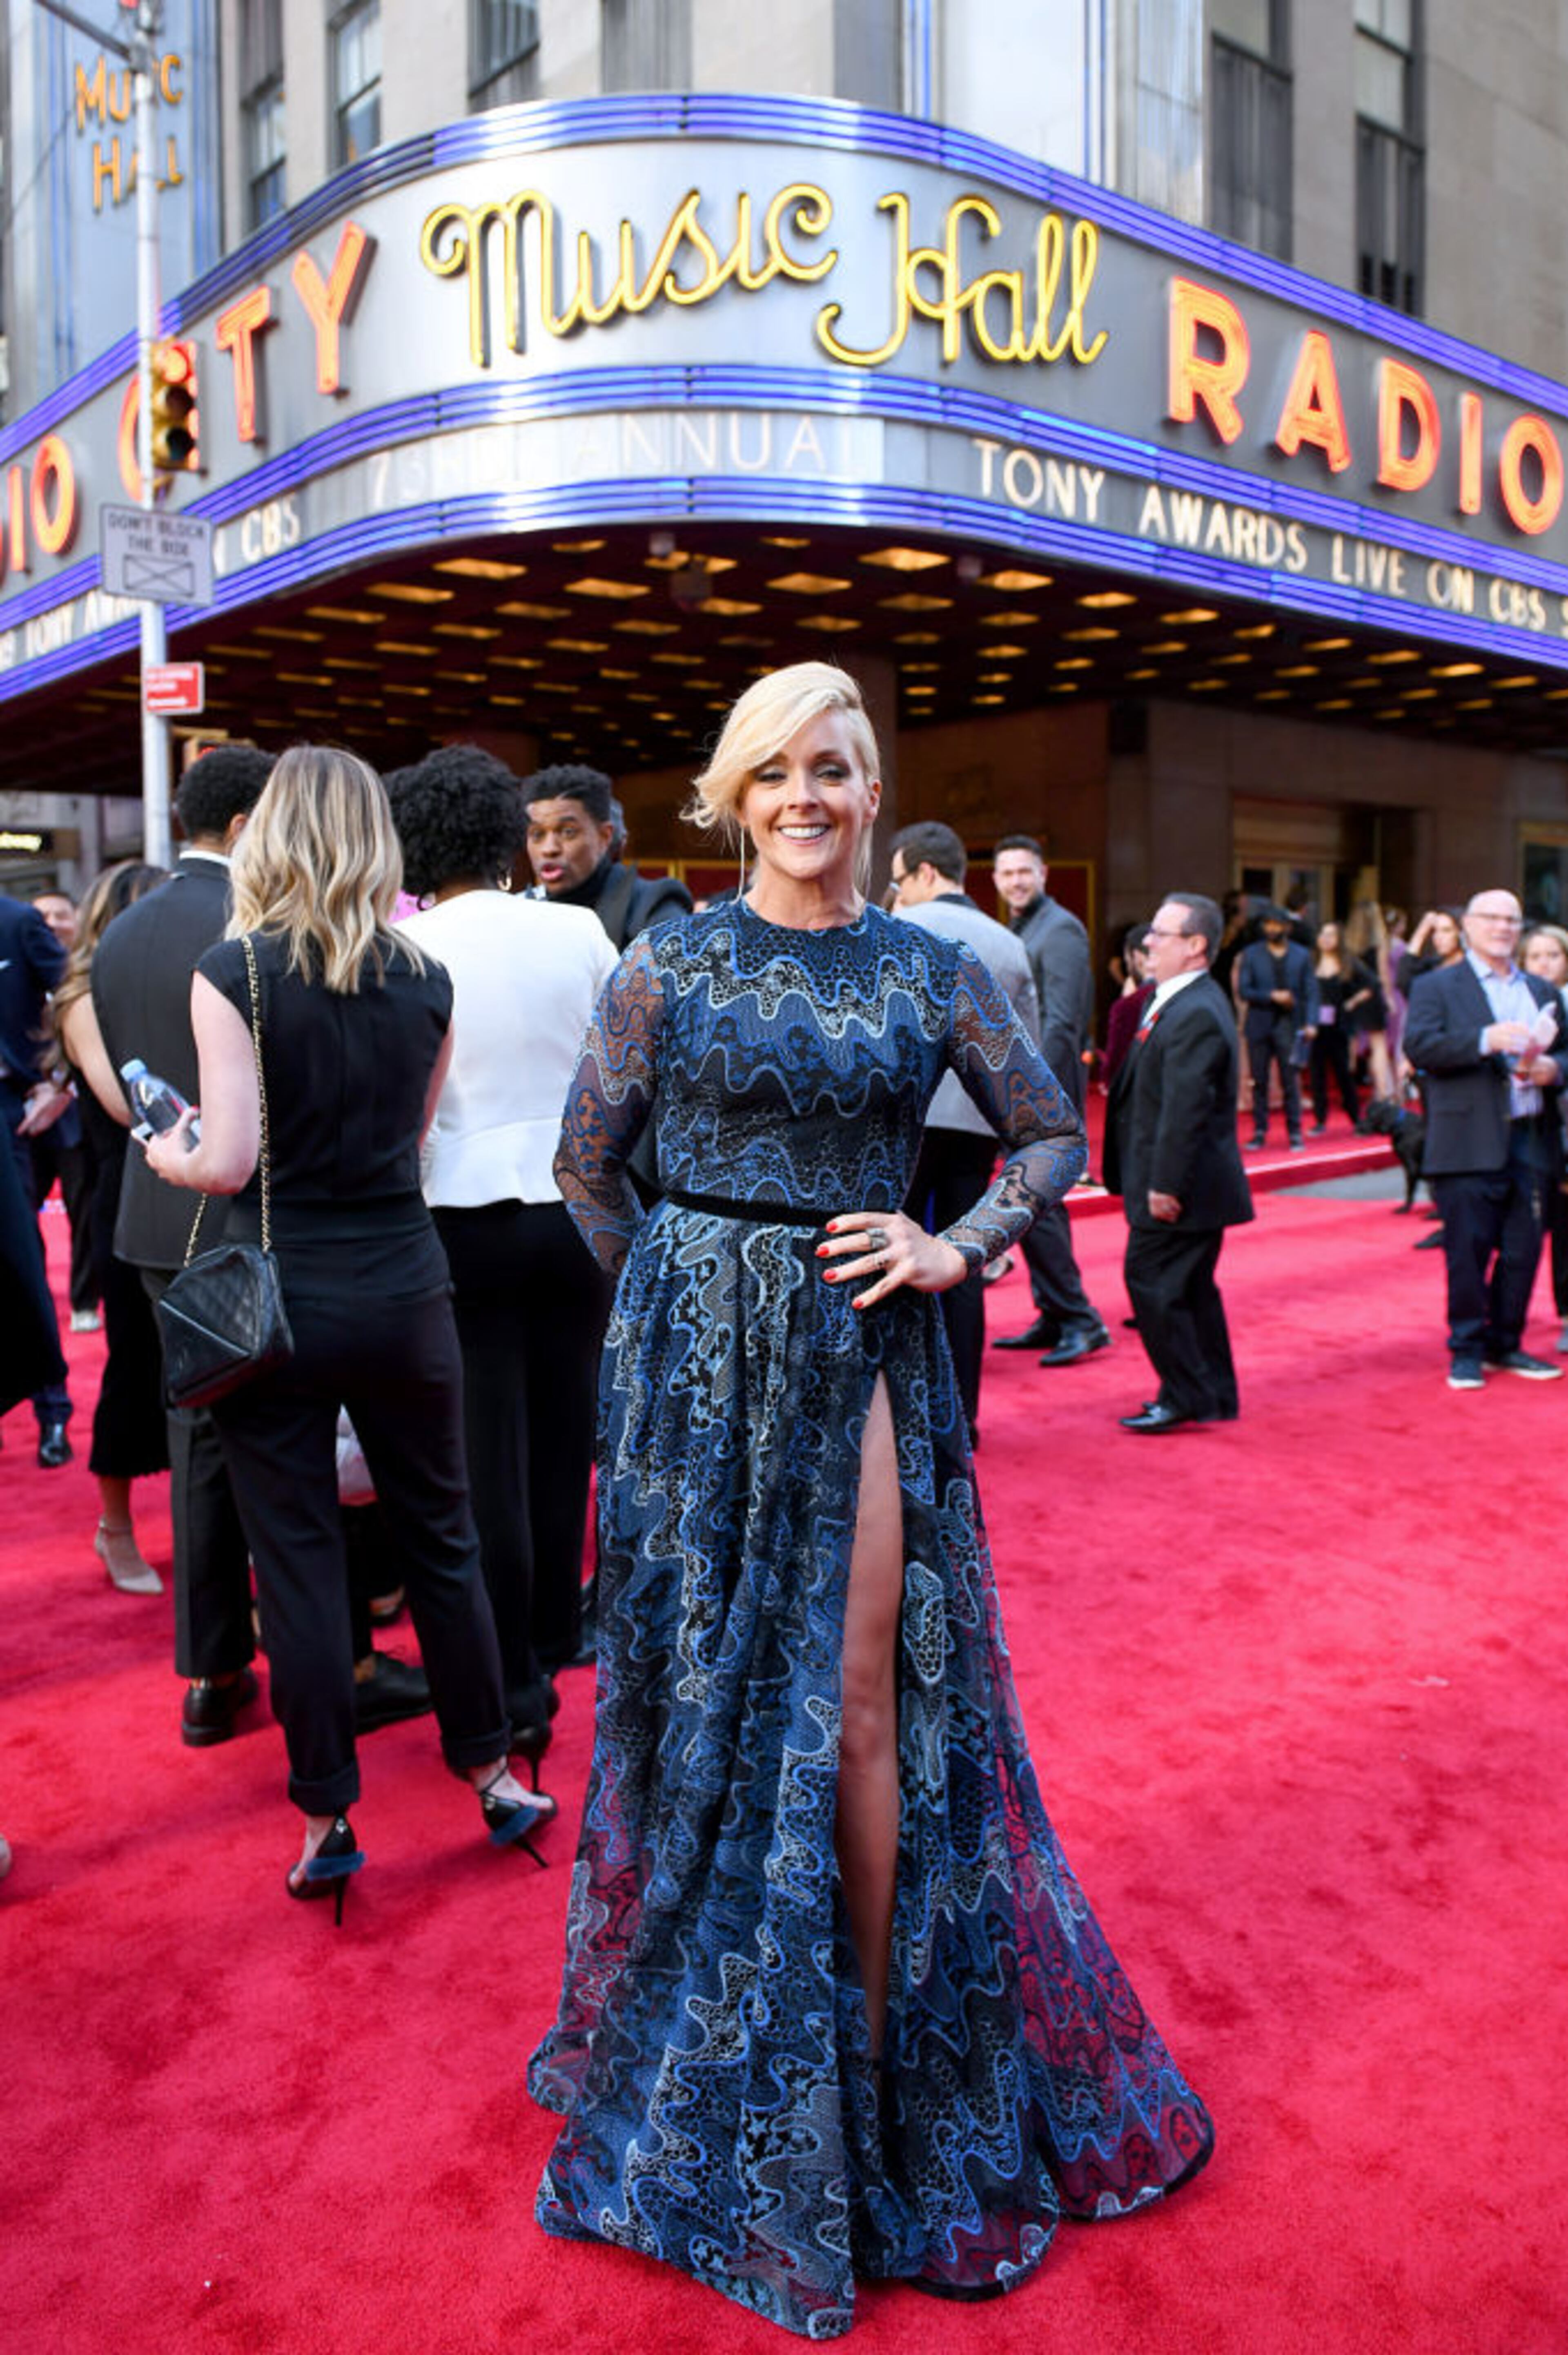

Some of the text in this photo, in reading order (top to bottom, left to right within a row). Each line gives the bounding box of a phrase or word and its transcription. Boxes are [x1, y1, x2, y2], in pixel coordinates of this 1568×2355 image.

[76, 54, 183, 129] MUC
[92, 136, 183, 210] HL
[816, 191, 1108, 365] Hall
[1169, 276, 1565, 536] RADIO
[128, 535, 153, 553] THE
[241, 495, 301, 562] CBS
[973, 438, 1105, 522] TONY
[1138, 485, 1307, 572] AWARDS
[1331, 535, 1406, 596] LIVE
[1427, 561, 1474, 613] ON
[1489, 578, 1546, 631] CBS
